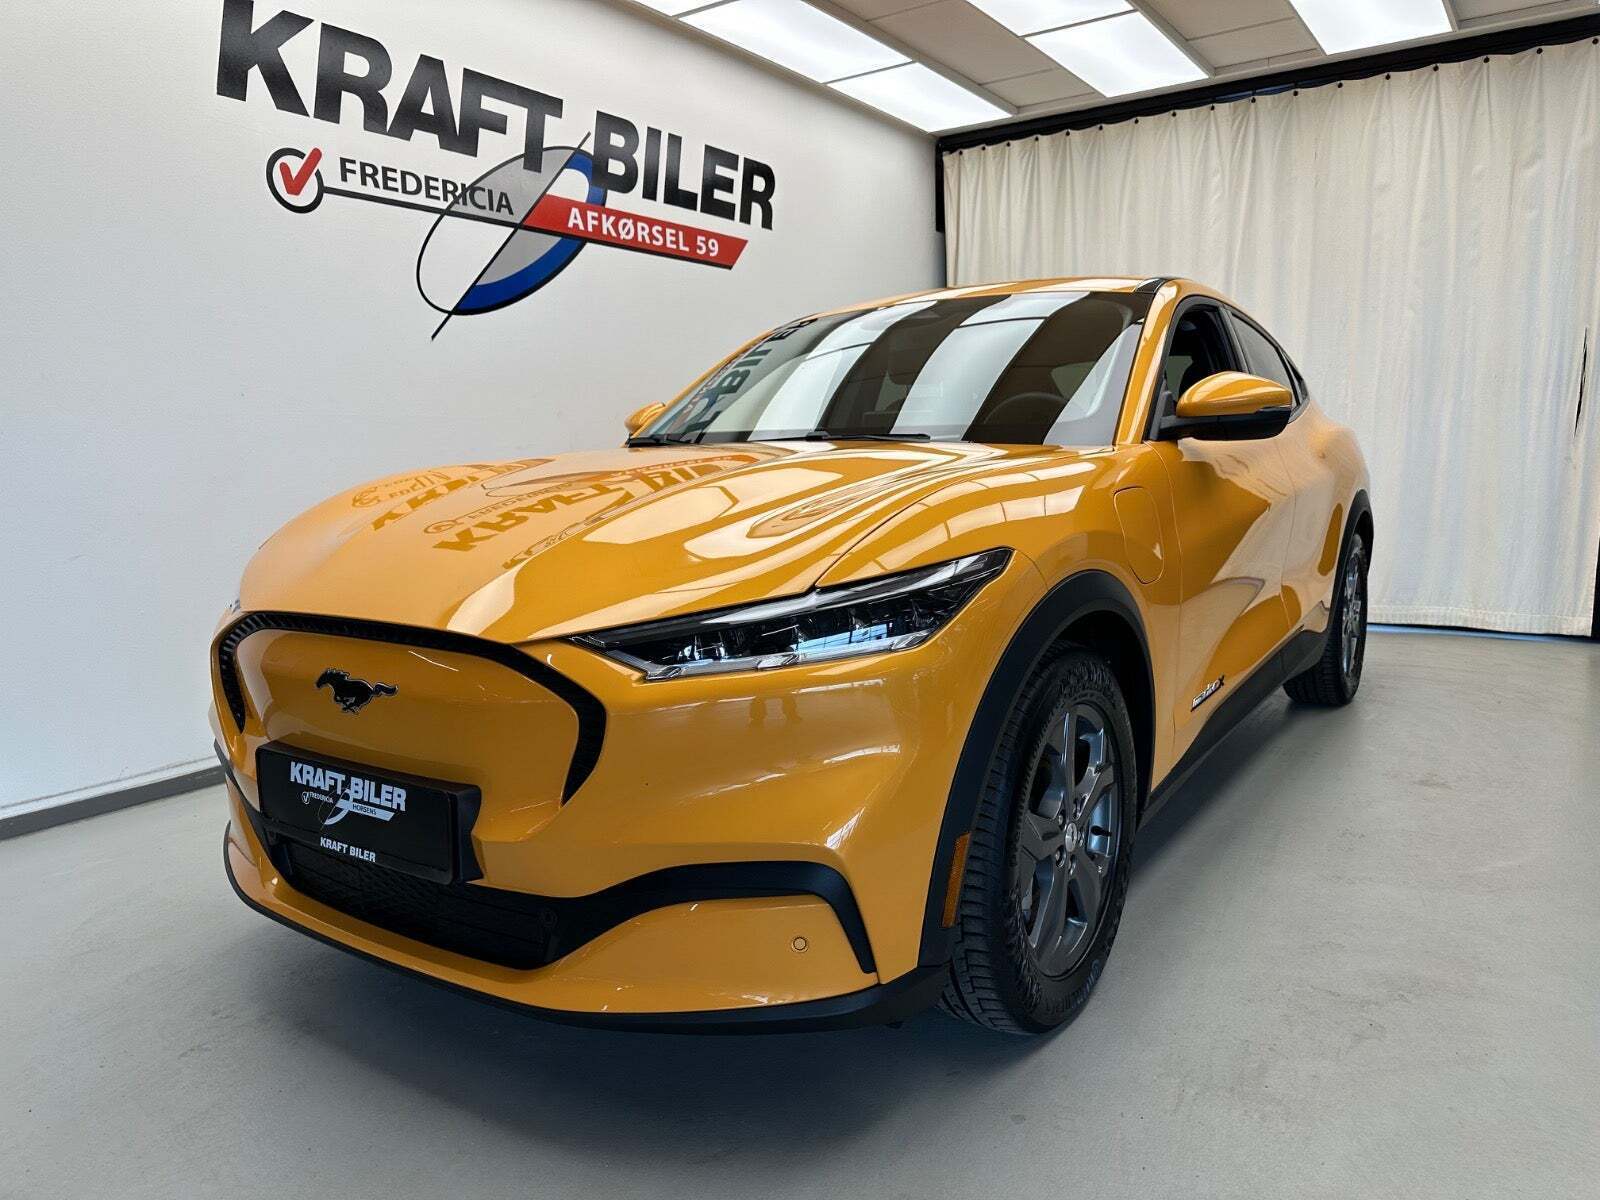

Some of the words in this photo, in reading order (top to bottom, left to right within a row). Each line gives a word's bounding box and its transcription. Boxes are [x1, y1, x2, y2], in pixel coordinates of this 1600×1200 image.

[216, 0, 564, 173] KRAFT
[592, 109, 777, 231] BILER
[339, 156, 514, 217] FREDERICIA
[567, 206, 690, 253] AFKØRSEL
[695, 235, 720, 258] 59
[290, 761, 346, 795] KRAFT
[350, 775, 407, 812] BILER
[320, 836, 348, 854] KRAFT
[349, 845, 376, 863] BILER
